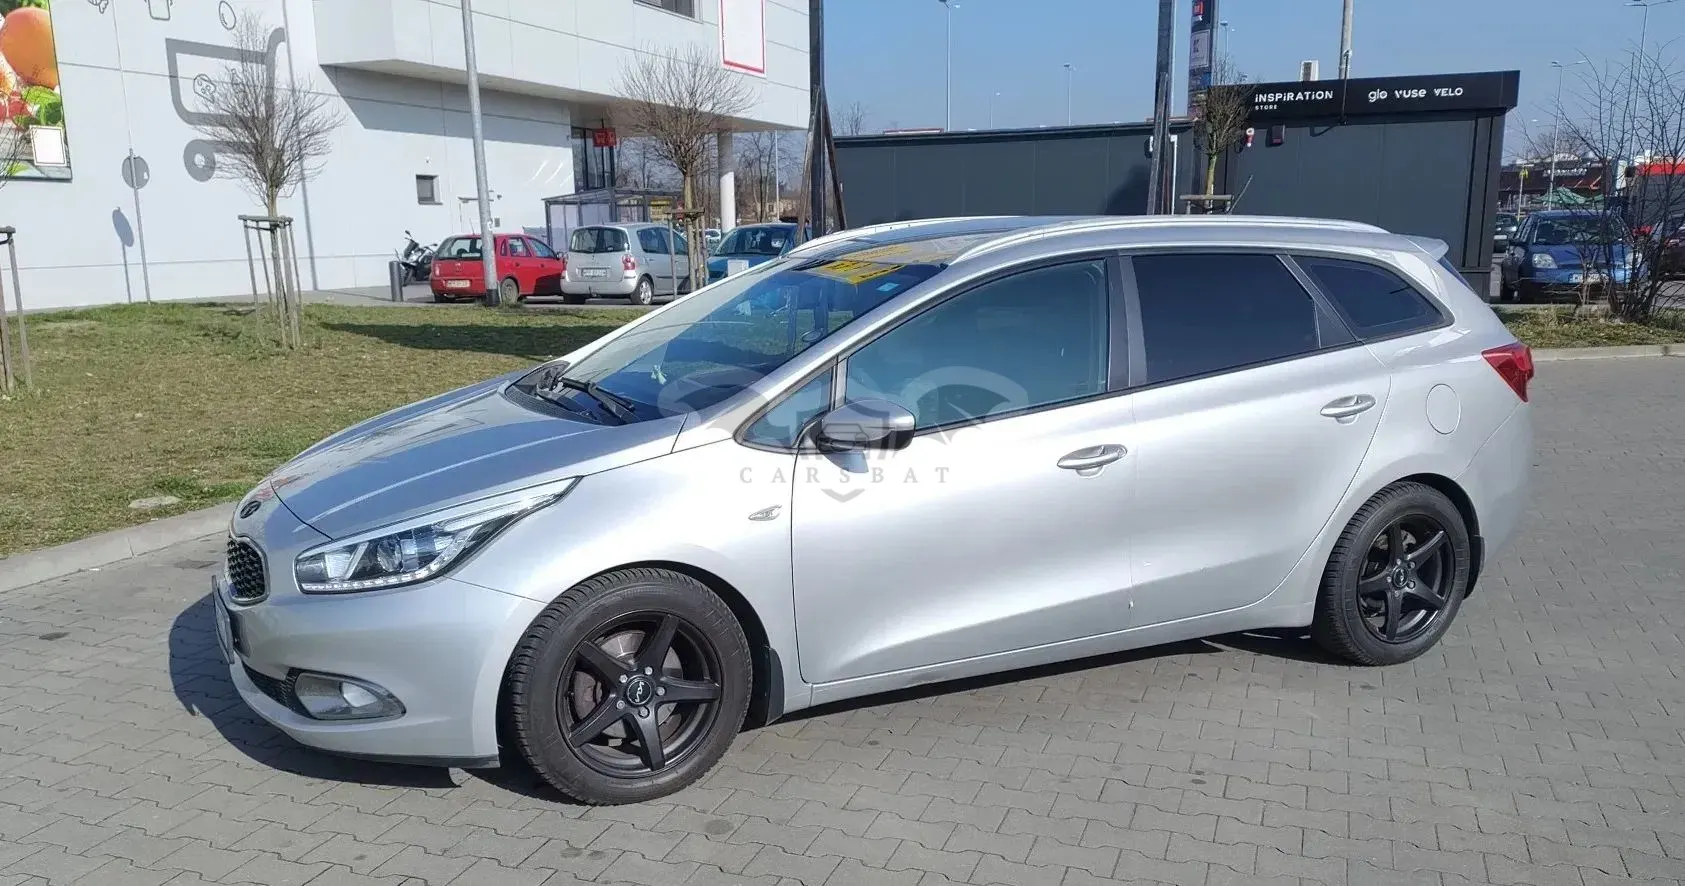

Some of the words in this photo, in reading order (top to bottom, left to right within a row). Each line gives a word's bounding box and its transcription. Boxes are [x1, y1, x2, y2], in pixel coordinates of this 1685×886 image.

[1368, 88, 1387, 102] glo
[1395, 89, 1427, 99] vuse
[1434, 87, 1463, 97] VELO
